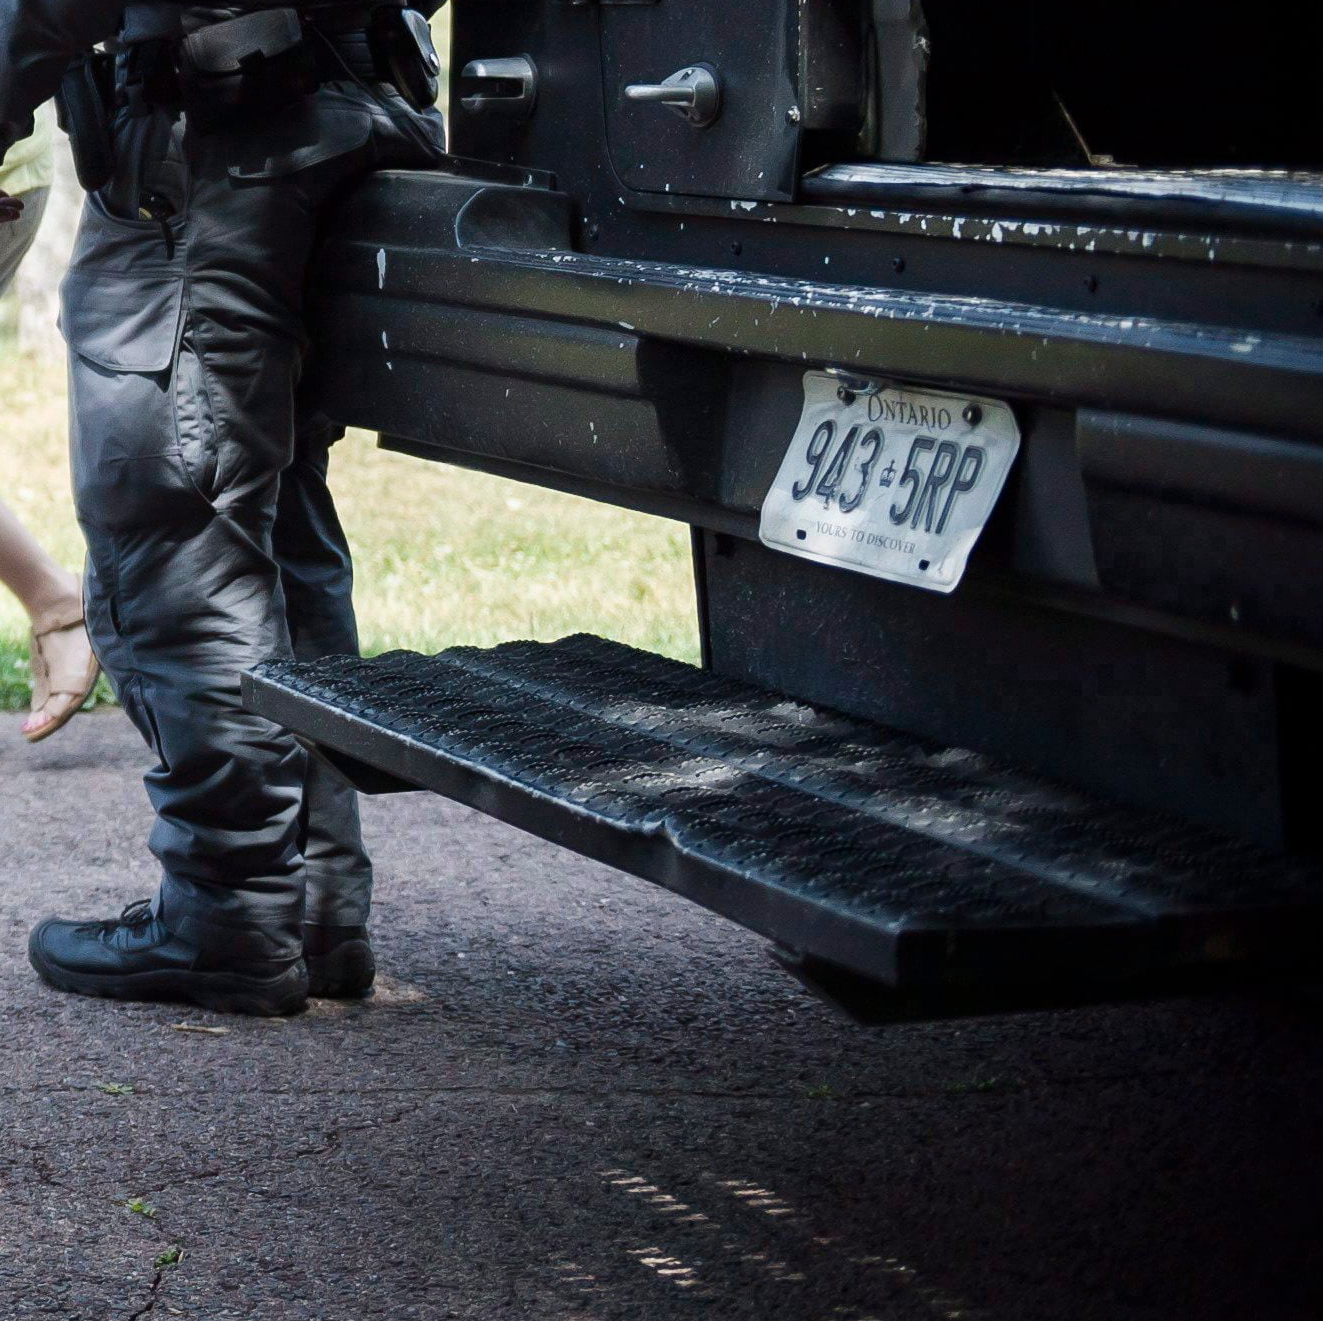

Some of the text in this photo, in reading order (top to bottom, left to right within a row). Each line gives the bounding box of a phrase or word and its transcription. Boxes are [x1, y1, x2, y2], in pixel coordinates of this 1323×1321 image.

[867, 394, 952, 430] ONTARIO
[816, 521, 916, 555] YOURS TO DISCOVER
